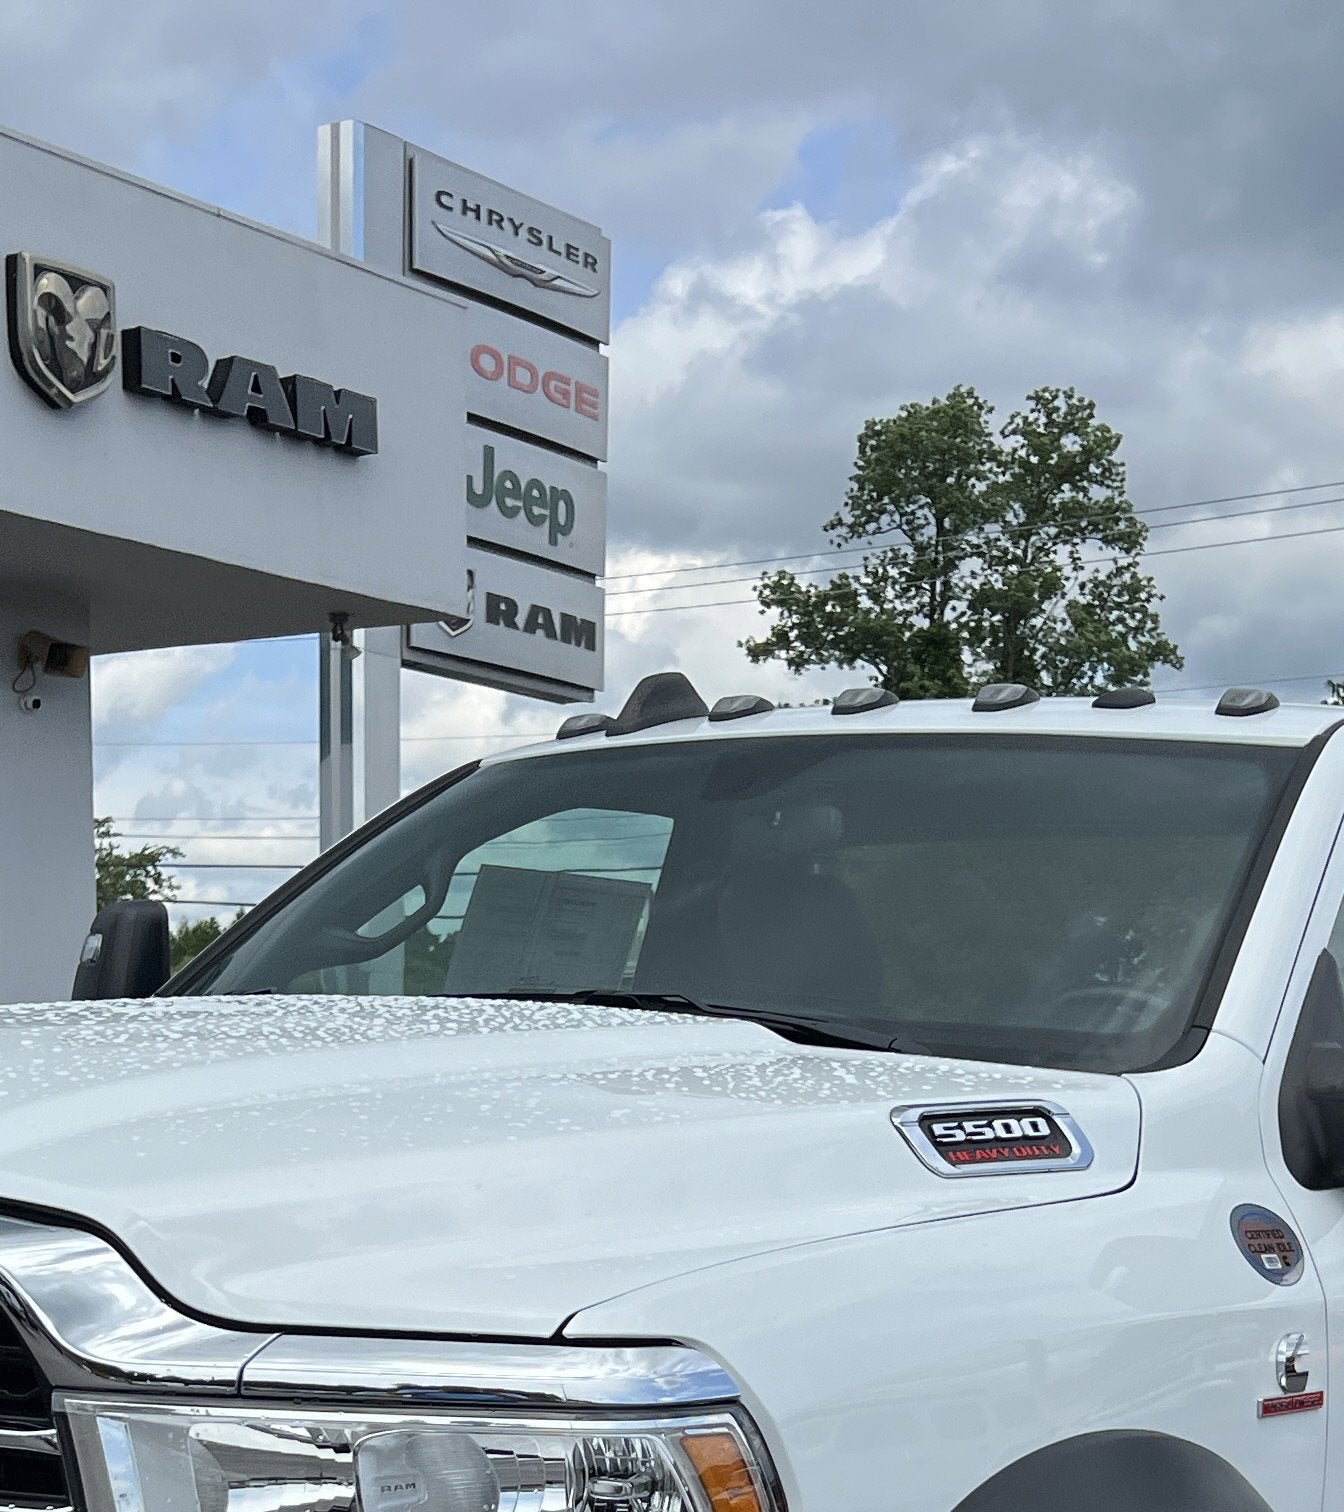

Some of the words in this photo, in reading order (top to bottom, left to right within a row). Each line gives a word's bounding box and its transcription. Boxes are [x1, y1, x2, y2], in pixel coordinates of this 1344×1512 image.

[434, 190, 599, 273] CHRYSLER
[122, 326, 379, 457] RAM
[470, 344, 599, 421] ODGE
[466, 445, 574, 546] Jeep
[486, 592, 597, 652] RAM
[931, 1117, 1051, 1142] 5500
[948, 1148, 1010, 1162] HEAVY
[1014, 1145, 1061, 1157] DUTY
[1245, 1229, 1285, 1240] CERTIFIED
[1247, 1243, 1276, 1254] CLEAN
[1277, 1242, 1295, 1252] IDLE
[380, 1482, 416, 1493] RAM
